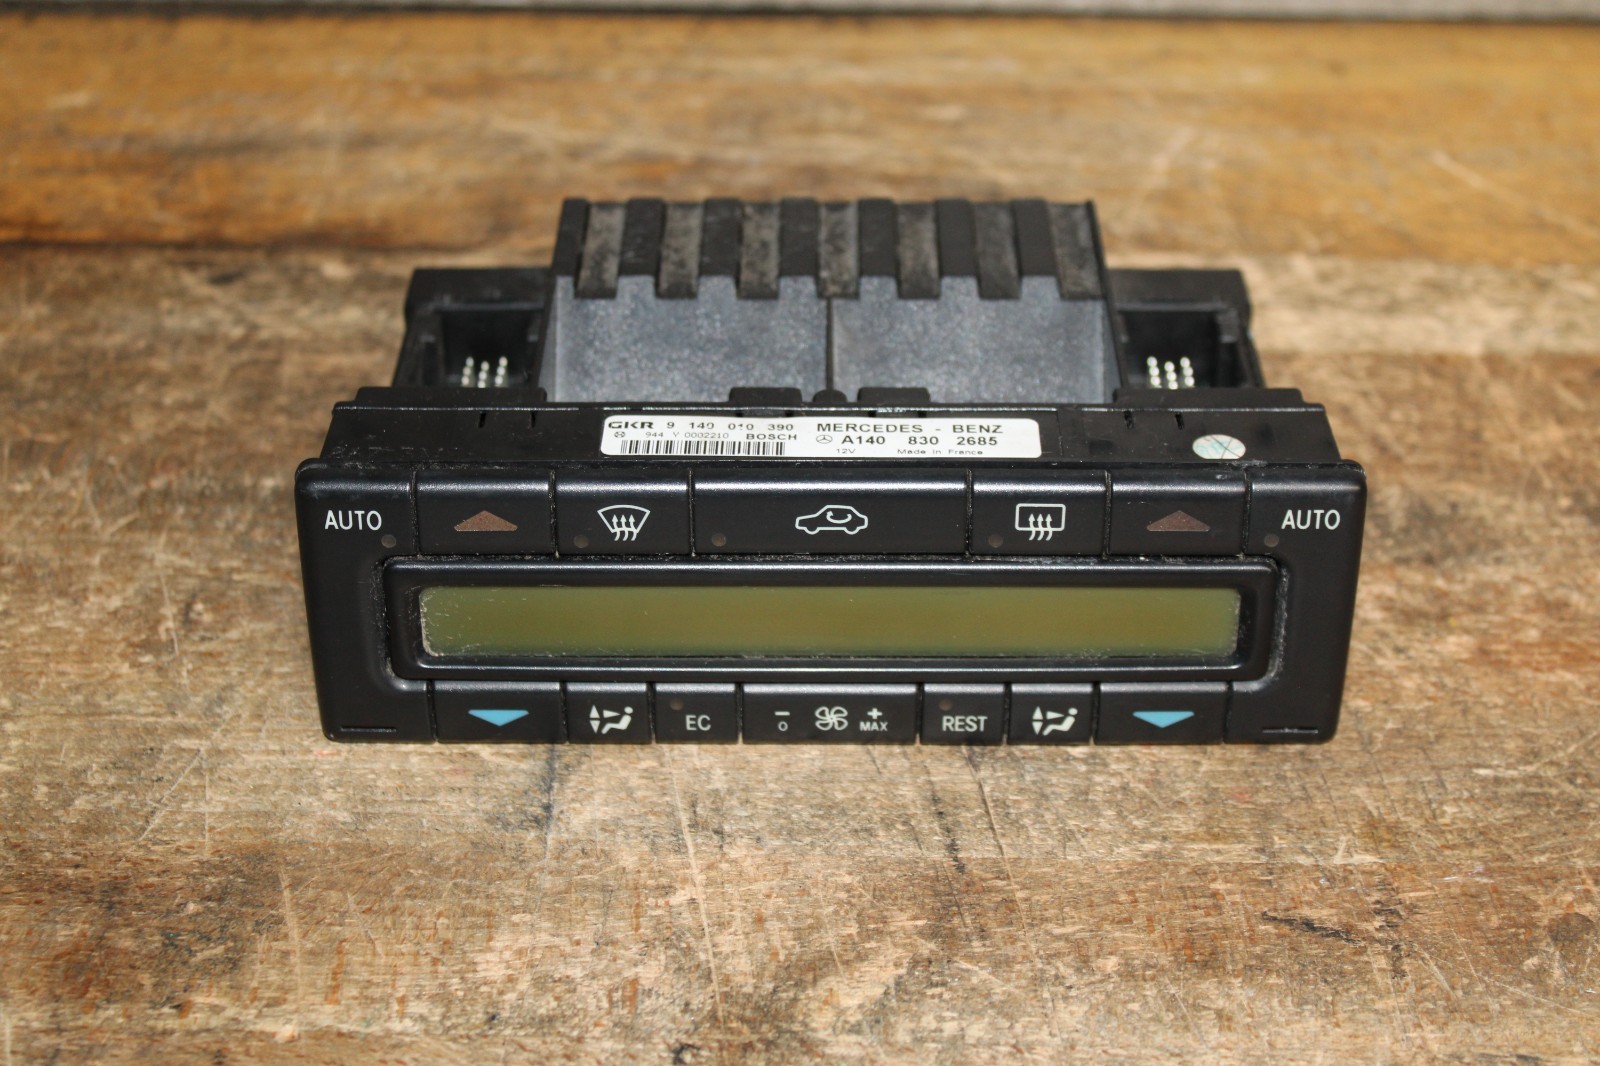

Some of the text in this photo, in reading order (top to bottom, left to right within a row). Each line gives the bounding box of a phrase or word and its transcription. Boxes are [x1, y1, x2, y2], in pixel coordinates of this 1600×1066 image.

[608, 421, 654, 430] GKR
[666, 421, 675, 429] 9
[768, 423, 794, 432] 390
[817, 423, 923, 433] MERCEDES
[952, 424, 1004, 434] BENZ
[746, 433, 798, 441] BOSCH
[842, 435, 998, 446] A140 830 2685
[897, 448, 926, 456] Made
[949, 448, 984, 456] France
[324, 509, 383, 531] AUTO
[1281, 509, 1341, 531] AUTO
[685, 714, 711, 731] EC
[859, 721, 888, 732] MAX
[942, 715, 988, 732] REST
